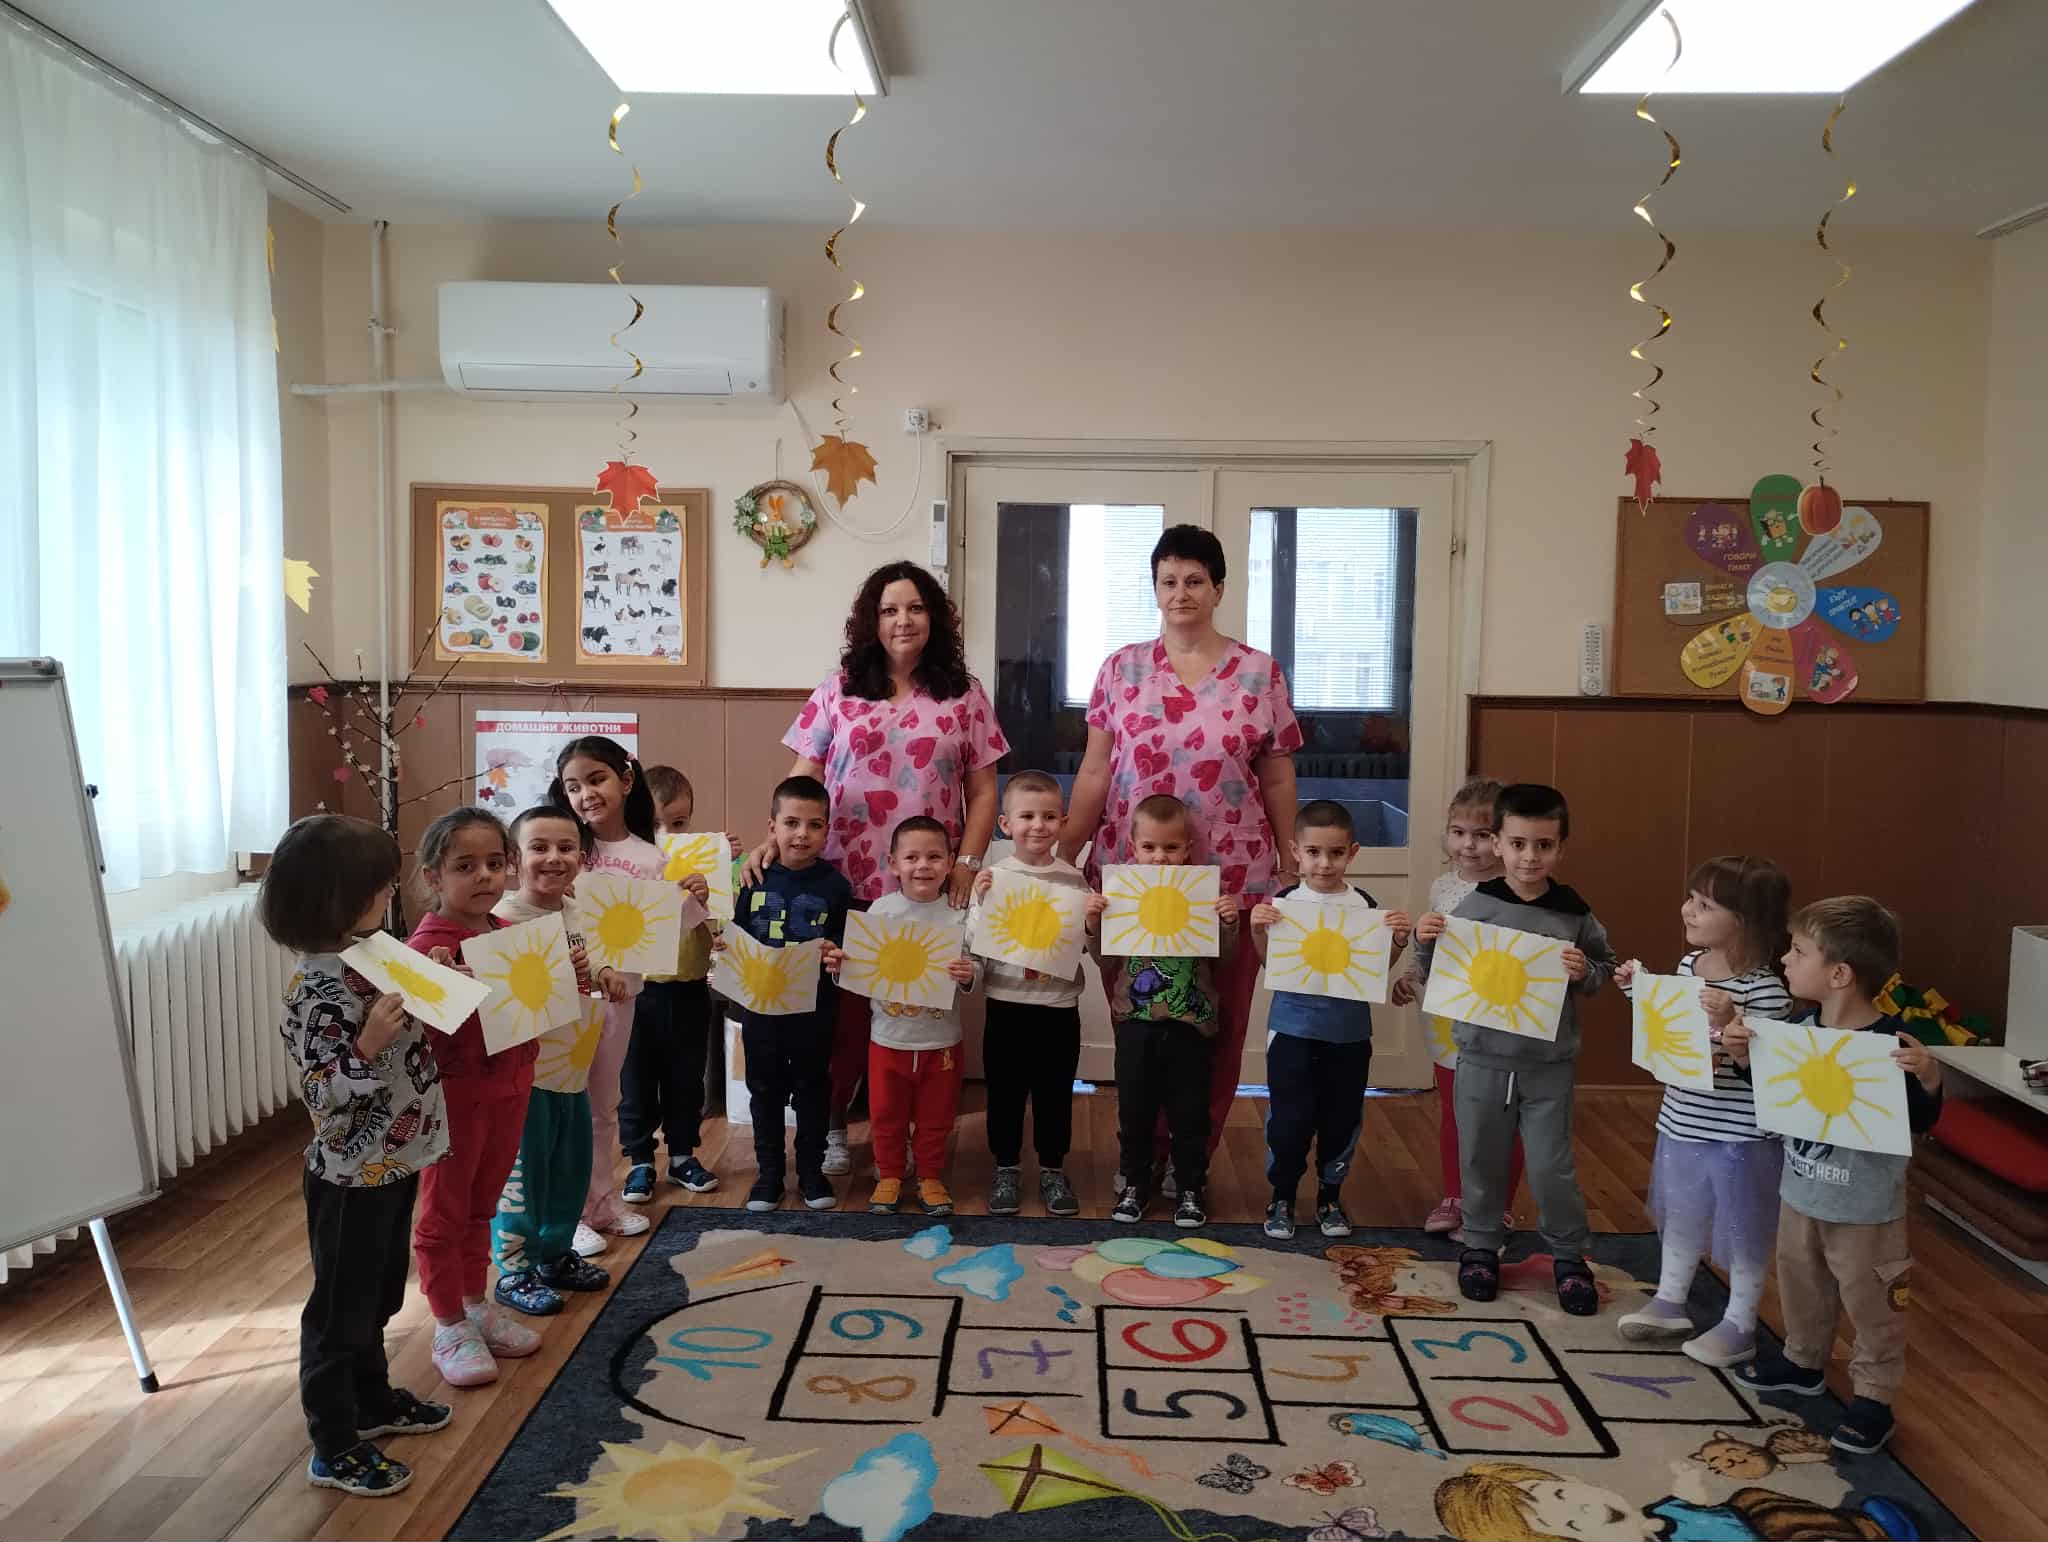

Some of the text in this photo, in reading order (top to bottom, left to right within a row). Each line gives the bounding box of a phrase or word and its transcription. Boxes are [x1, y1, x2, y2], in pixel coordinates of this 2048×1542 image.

[495, 722, 622, 734] ДОМАШНИ ЖИВОТНИ
[1816, 1163, 1849, 1183] HERO
[829, 1308, 923, 1343] 9
[1122, 1319, 1229, 1364] 6
[656, 1325, 773, 1382] 10
[977, 1338, 1071, 1381] 7
[1411, 1327, 1529, 1365] 3
[1270, 1353, 1368, 1385] 4
[1589, 1369, 1696, 1400] 1
[807, 1373, 916, 1405] 8
[1124, 1386, 1248, 1421] 5
[1452, 1394, 1569, 1437] 2
